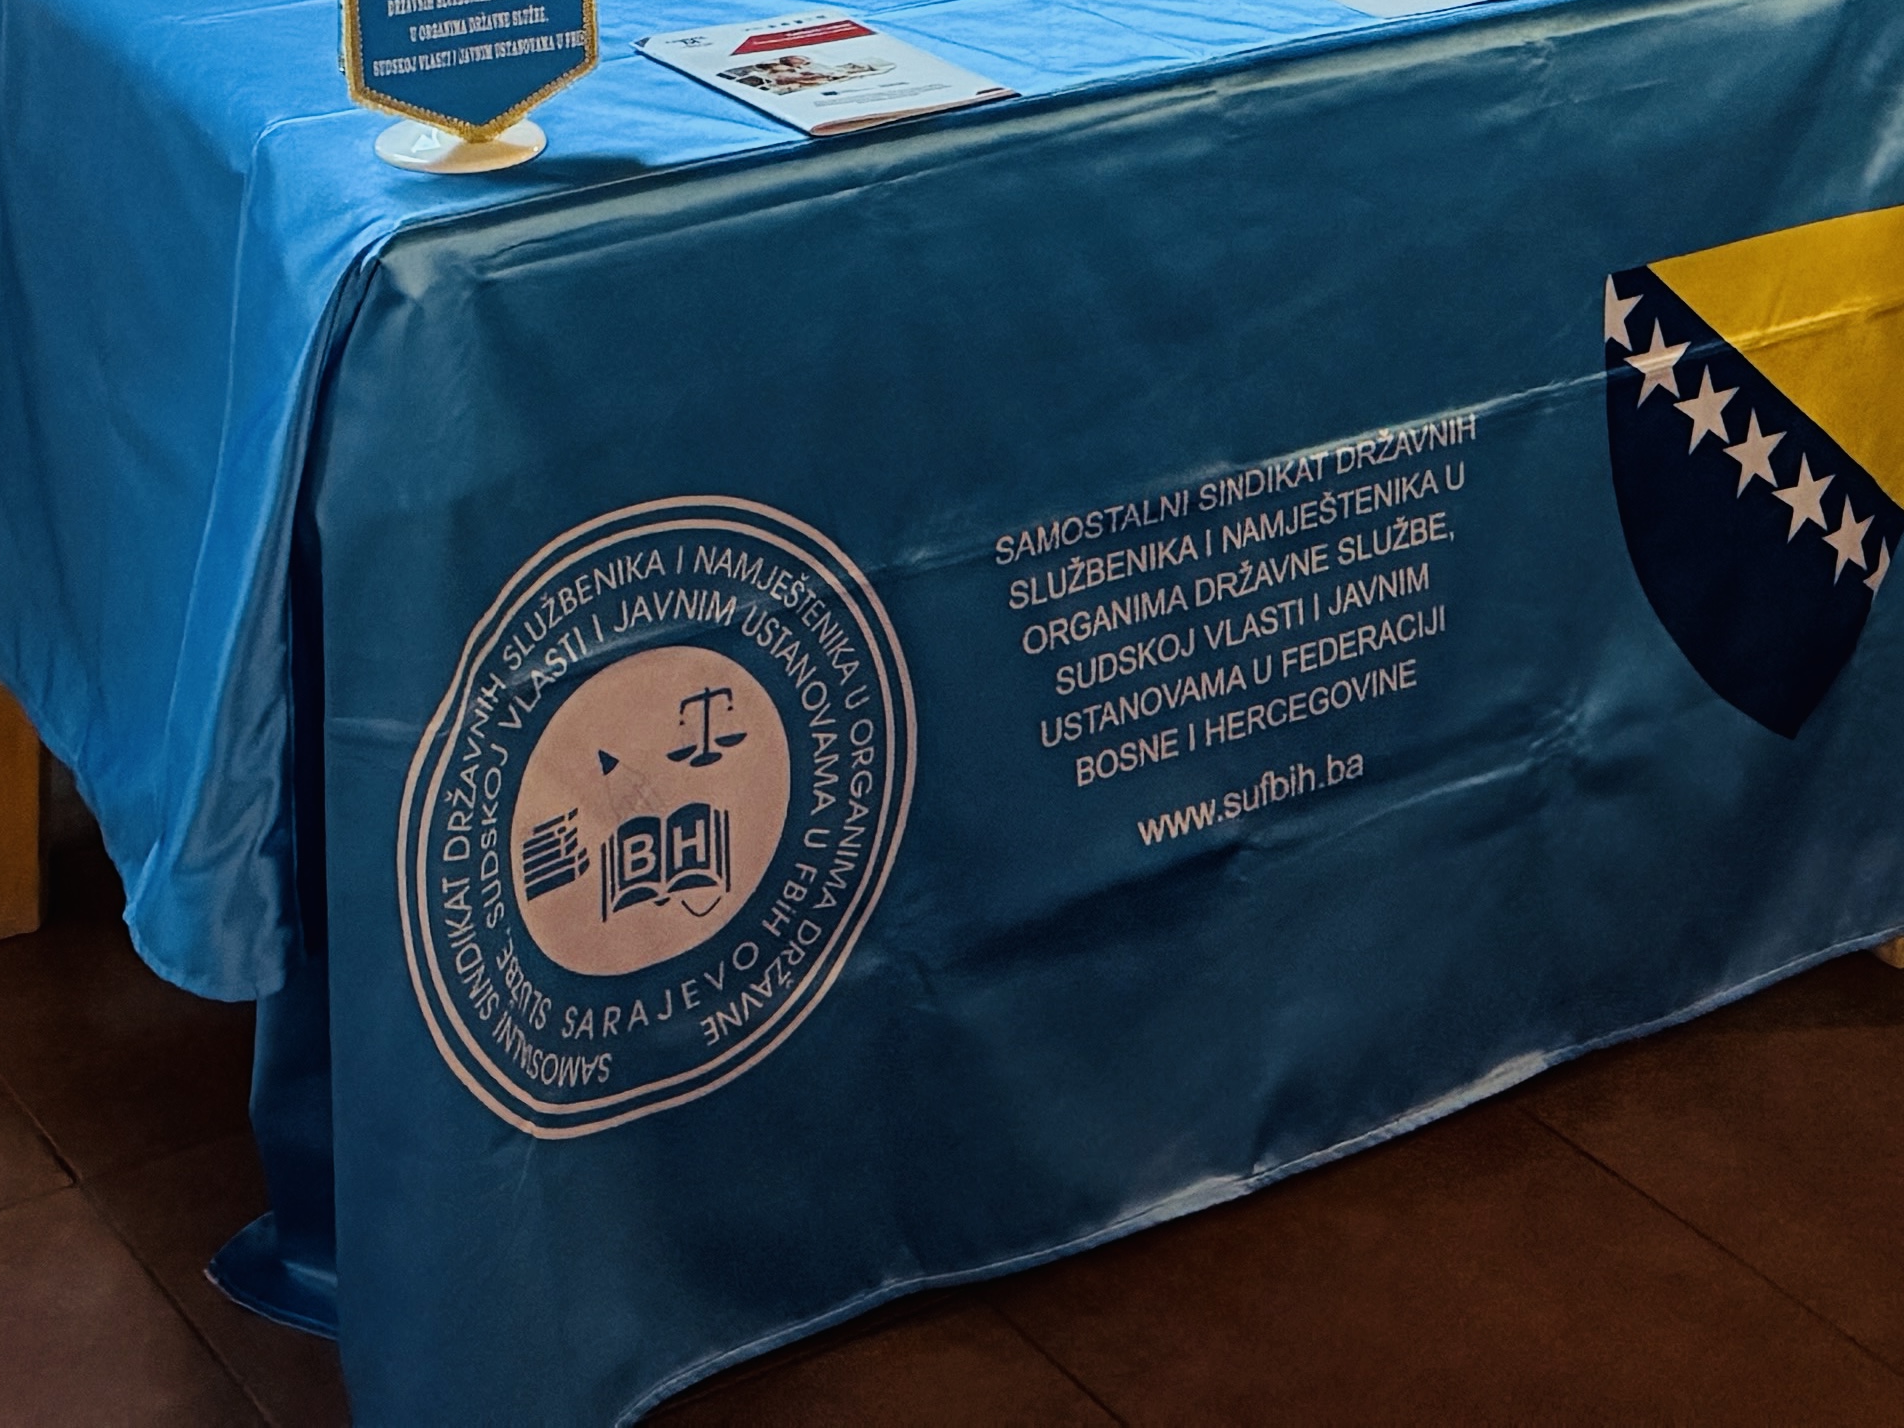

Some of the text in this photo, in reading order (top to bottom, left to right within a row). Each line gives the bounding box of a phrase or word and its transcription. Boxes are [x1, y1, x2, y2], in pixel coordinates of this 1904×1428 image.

[995, 414, 1477, 565] SAMOSTALNI SINDIKAT DRŽAVNIH
[1008, 461, 1466, 610] SLUŽBENIKA I NAMJEŠTENIKA U
[503, 548, 666, 671] SLUŽBENIKA
[676, 545, 684, 575] I
[693, 545, 861, 686] NAMJEŠTENIKA
[1021, 511, 1456, 655] ORGANIMA DRŽAVNE SLUŽBE,
[845, 685, 870, 710] U
[1040, 605, 1446, 748] USTANOVAMA U FEDERACIJI
[1055, 563, 1430, 696] SUDSKOJ VLASTI I JAVNIM
[443, 672, 507, 862] DRŽAVNIH
[481, 743, 509, 929] SUDSKOJ
[498, 626, 588, 729] VLASTI
[592, 613, 604, 643] I
[613, 588, 738, 633] JAVNIM
[741, 605, 840, 816] USTANOVAMA
[803, 828, 832, 849] U
[1076, 658, 1418, 787] BOSNE I HERCEGOVINE
[623, 819, 706, 881] B H
[812, 718, 875, 910] ORGANIMA
[1137, 751, 1365, 847] www.sufbih.ba
[442, 877, 500, 1021] SINDIKAT
[561, 941, 760, 1041] SARAJEVO
[700, 919, 823, 1046] DRŽAVNE
